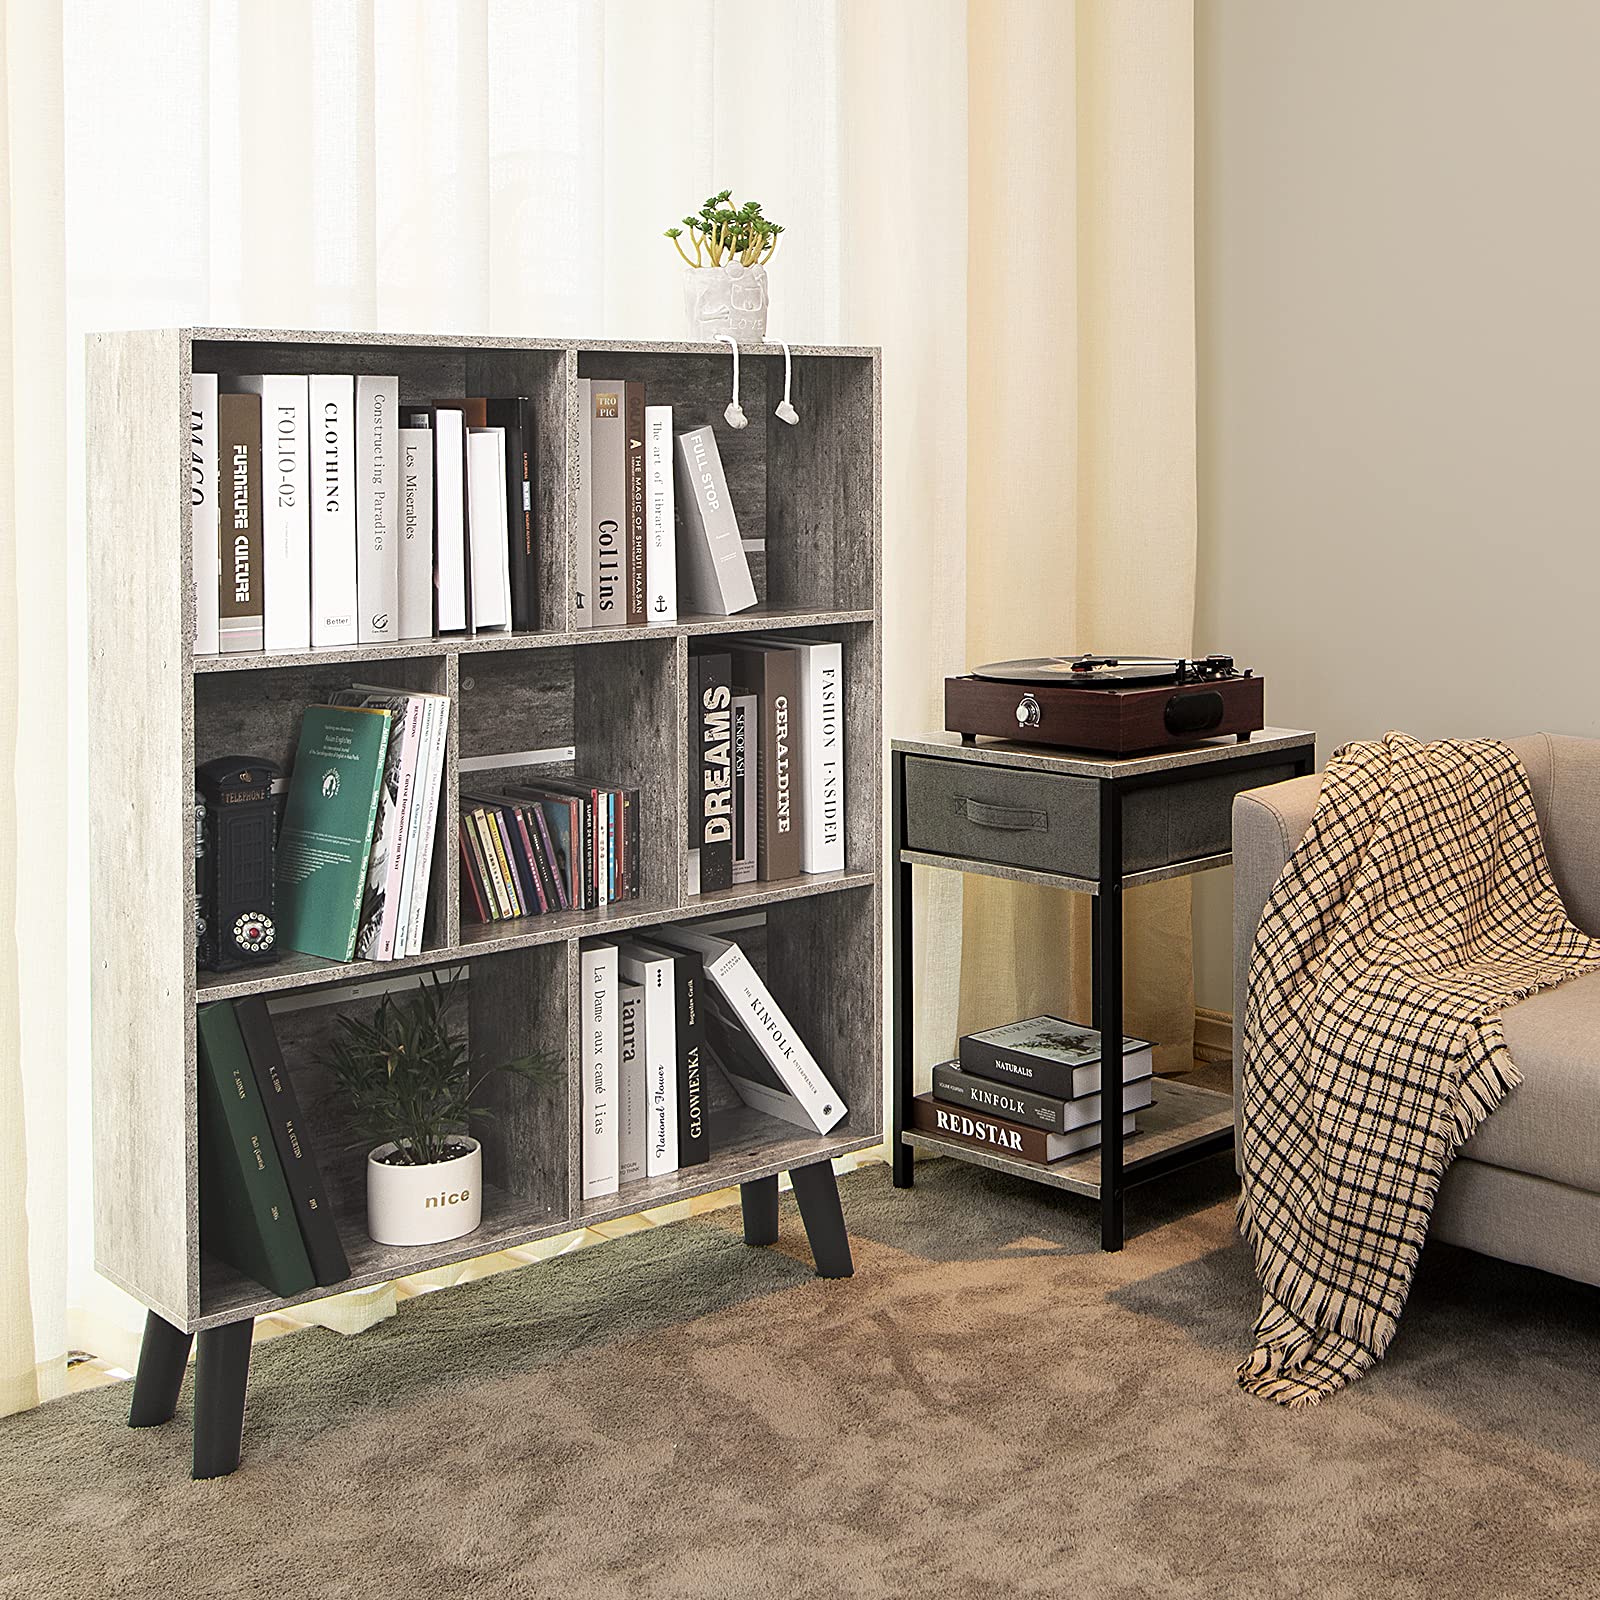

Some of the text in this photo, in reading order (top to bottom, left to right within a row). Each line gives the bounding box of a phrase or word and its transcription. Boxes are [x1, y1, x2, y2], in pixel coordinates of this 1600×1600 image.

[600, 398, 616, 406] TRO
[600, 408, 615, 416] PIC
[278, 407, 296, 508] FOLIO-02
[324, 403, 340, 513] CLOTHING
[372, 394, 386, 551] Constructing Paradies
[653, 422, 664, 548] The art of libraries
[691, 434, 720, 512] FULL STOP.
[406, 446, 418, 540] Les Miserables
[636, 516, 642, 530] OF
[234, 536, 250, 602] CULTURE
[598, 520, 618, 611] Collins
[326, 618, 348, 626] Better
[381, 727, 389, 743] Asian
[410, 705, 418, 738] RENDITIONS
[822, 668, 836, 748] FASHION
[703, 685, 731, 844] DREAMS
[736, 714, 745, 778] SENIOR ASH
[225, 789, 266, 804] TELEPHONE
[398, 798, 407, 833] IMPRESSIONS
[594, 966, 606, 1135] La Dame aux camé lias
[622, 998, 640, 1063] ianra
[744, 987, 752, 998] THE
[750, 998, 794, 1060] KINFOLK
[980, 1018, 1051, 1041] NATURALIS
[970, 1088, 1025, 1114] KINFOLK
[995, 1060, 1032, 1078] NATURALIS
[655, 1064, 666, 1158] National Flower
[935, 1110, 1024, 1152] REDSTAR
[426, 1190, 470, 1208] nice
